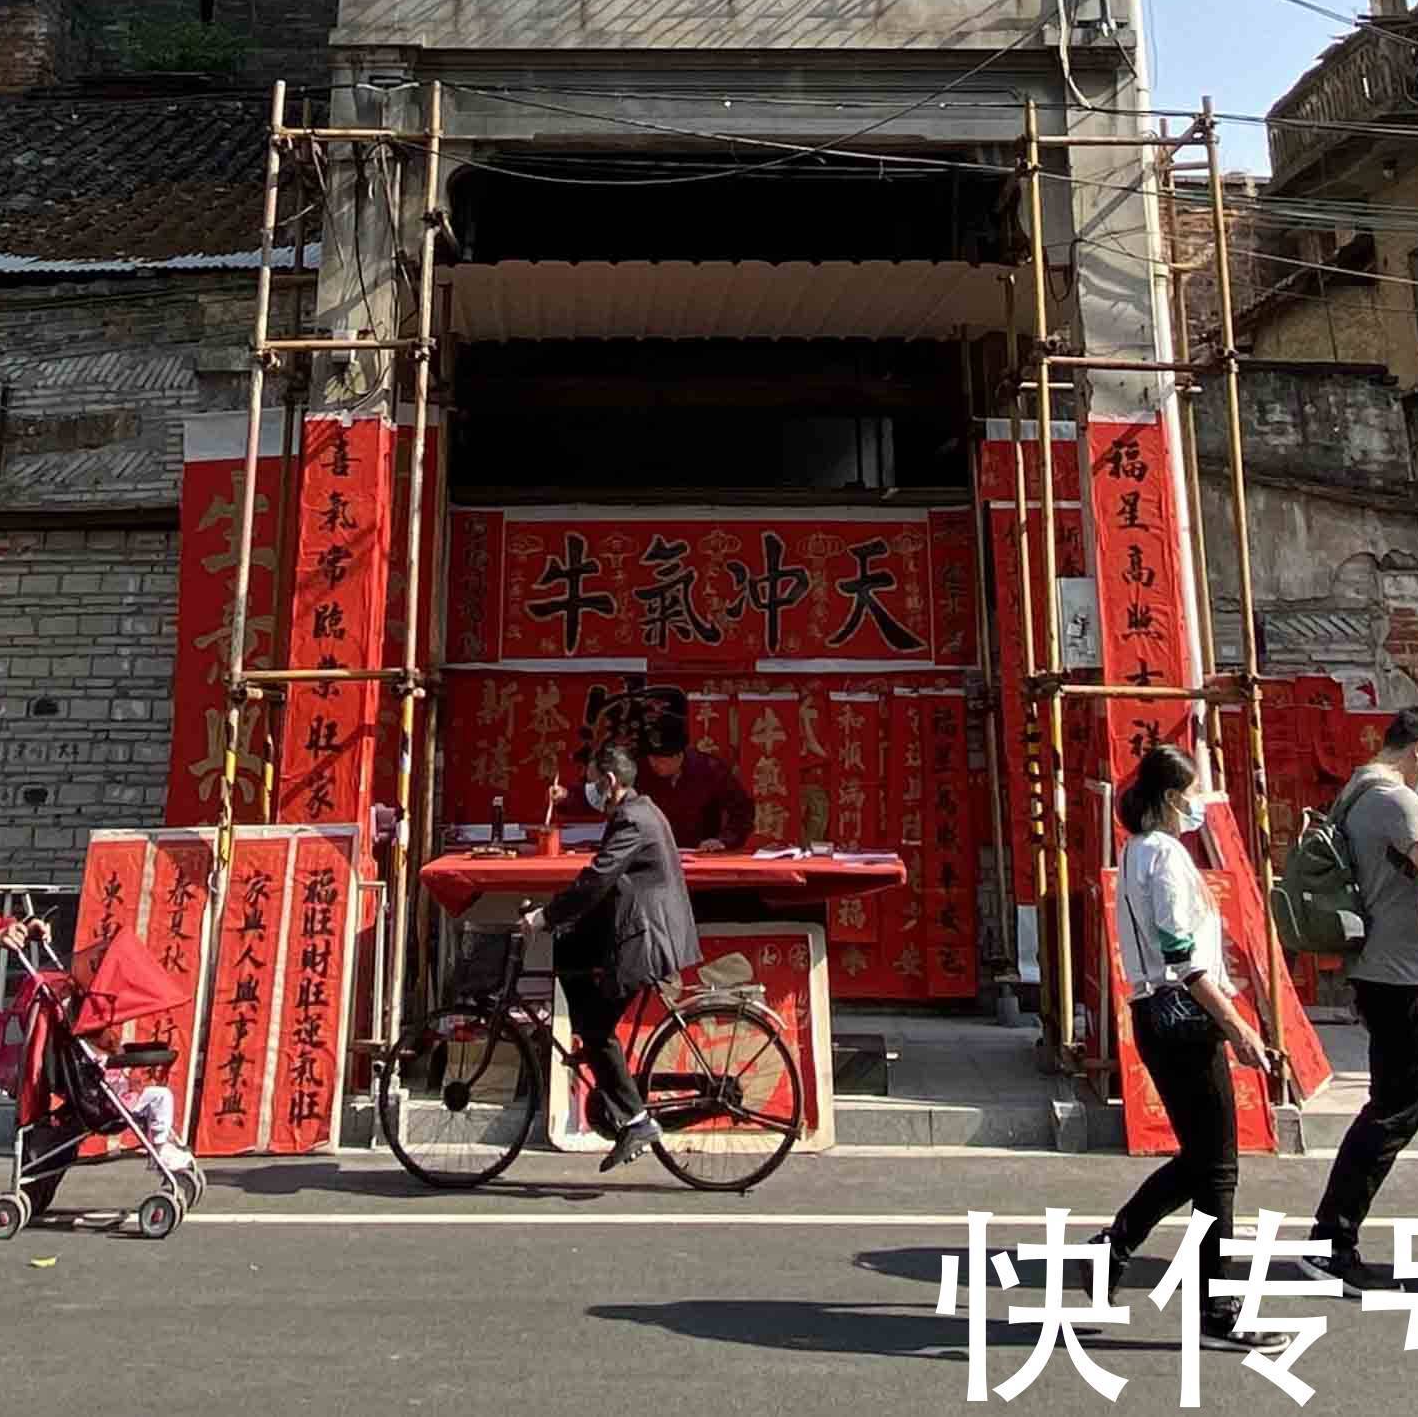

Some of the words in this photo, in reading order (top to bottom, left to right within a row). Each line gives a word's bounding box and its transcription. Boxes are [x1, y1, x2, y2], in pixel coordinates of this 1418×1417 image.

[287, 869, 338, 1126] 福旺財旺運氣旺
